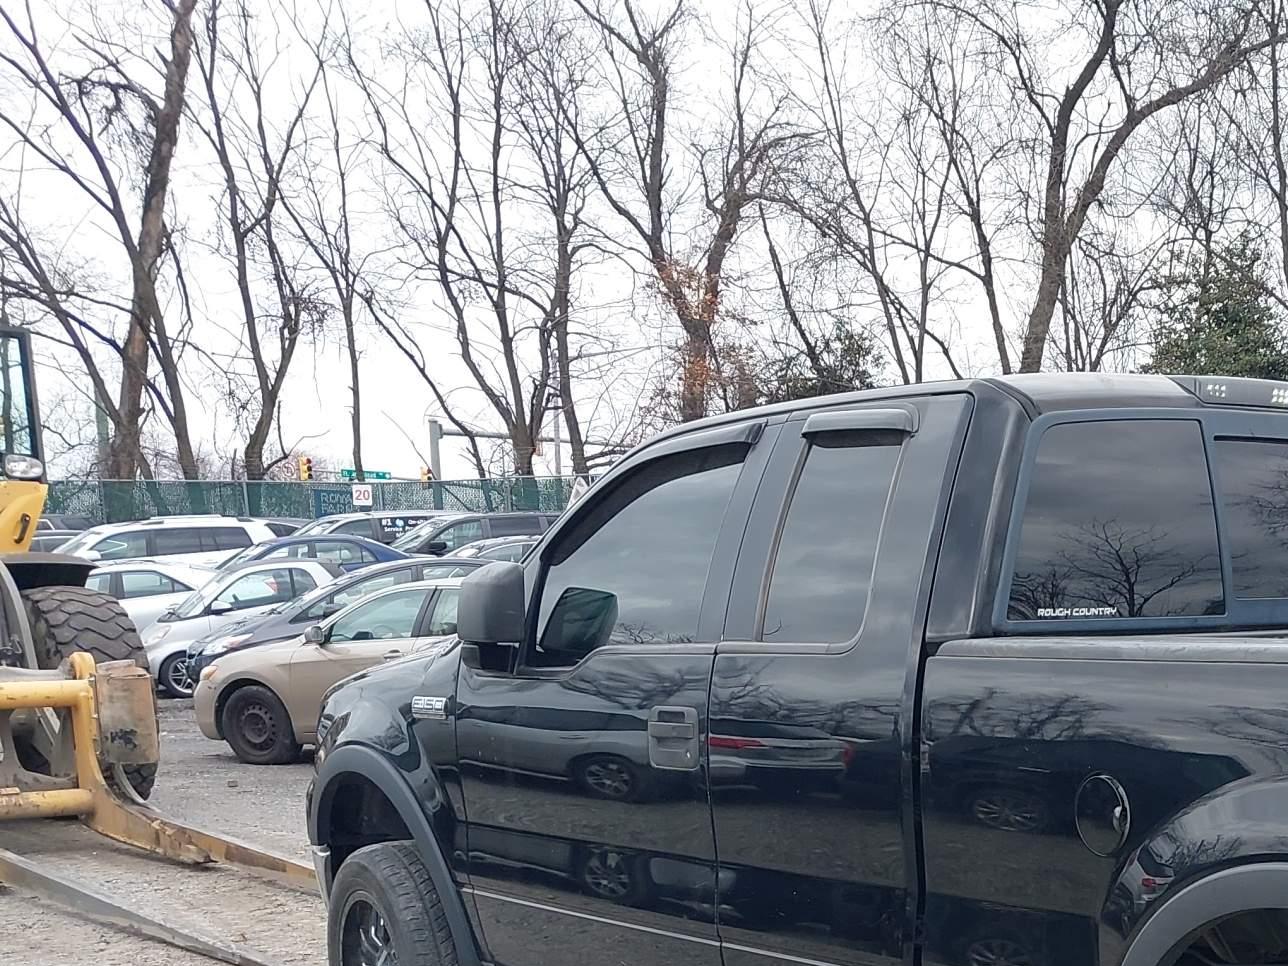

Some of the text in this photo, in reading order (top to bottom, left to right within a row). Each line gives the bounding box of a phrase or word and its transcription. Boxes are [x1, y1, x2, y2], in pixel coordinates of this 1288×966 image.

[355, 489, 370, 501] 20
[1037, 607, 1117, 617] ROUGH COUNTRY
